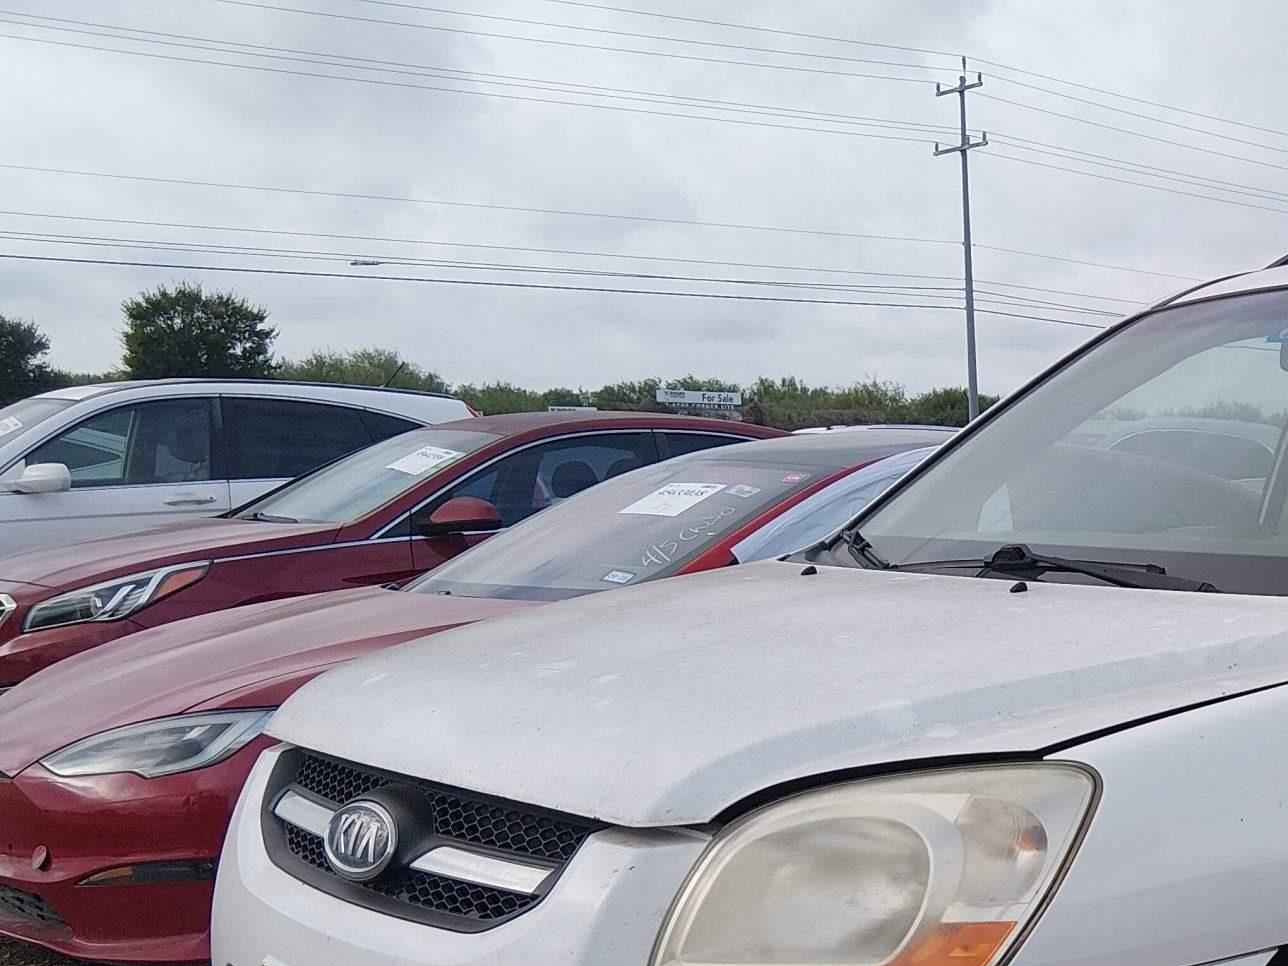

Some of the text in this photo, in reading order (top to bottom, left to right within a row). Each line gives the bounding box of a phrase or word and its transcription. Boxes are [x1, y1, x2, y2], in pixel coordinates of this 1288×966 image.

[702, 393, 734, 403] For Sale
[334, 813, 381, 863] KIA
